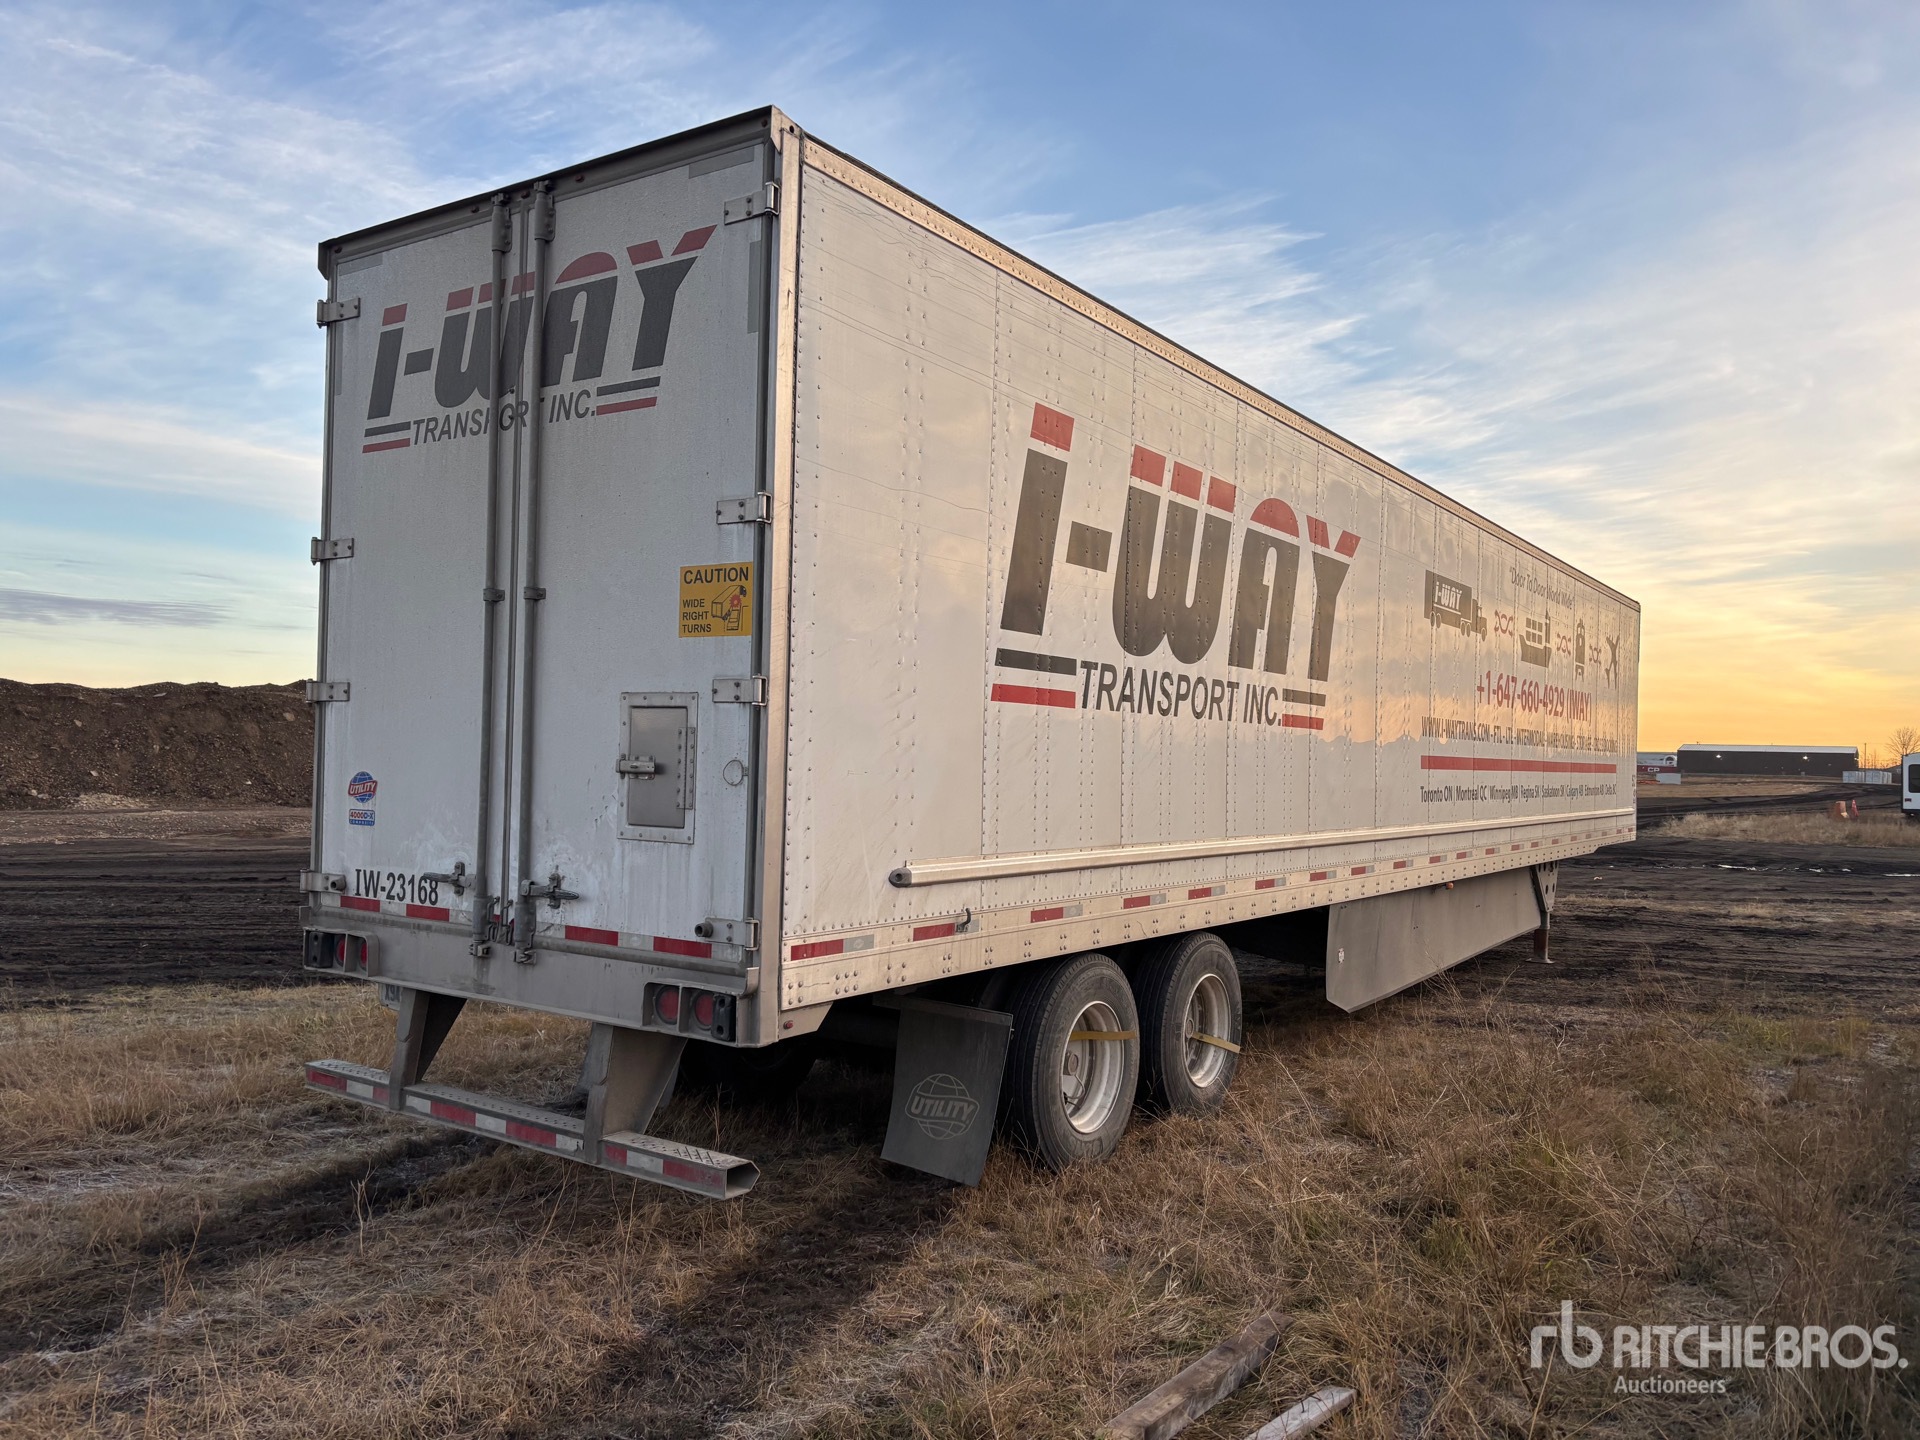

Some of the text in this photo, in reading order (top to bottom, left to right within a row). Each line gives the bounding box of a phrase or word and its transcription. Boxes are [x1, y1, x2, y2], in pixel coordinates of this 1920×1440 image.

[413, 389, 595, 446] TRANSOR INC.
[683, 567, 749, 584] CAUTION
[682, 599, 705, 608] WIDE
[682, 611, 710, 621] RIGHT
[682, 624, 712, 633] TURNS
[1080, 660, 1281, 726] TRANSPORT INC.
[1477, 670, 1592, 727] +1-647-660-4929 (IWAY)
[1493, 725, 1502, 744] FTL
[350, 782, 376, 794] UTILITY
[1420, 786, 1443, 802] Toronto
[1444, 785, 1453, 801] ON
[1456, 785, 1479, 801] Montreal
[1480, 785, 1487, 801] QC
[1490, 785, 1511, 803] Winnipeg
[350, 811, 374, 820] 4000D-X
[354, 869, 439, 906] IW-23168
[910, 1095, 976, 1122] UTILITY
